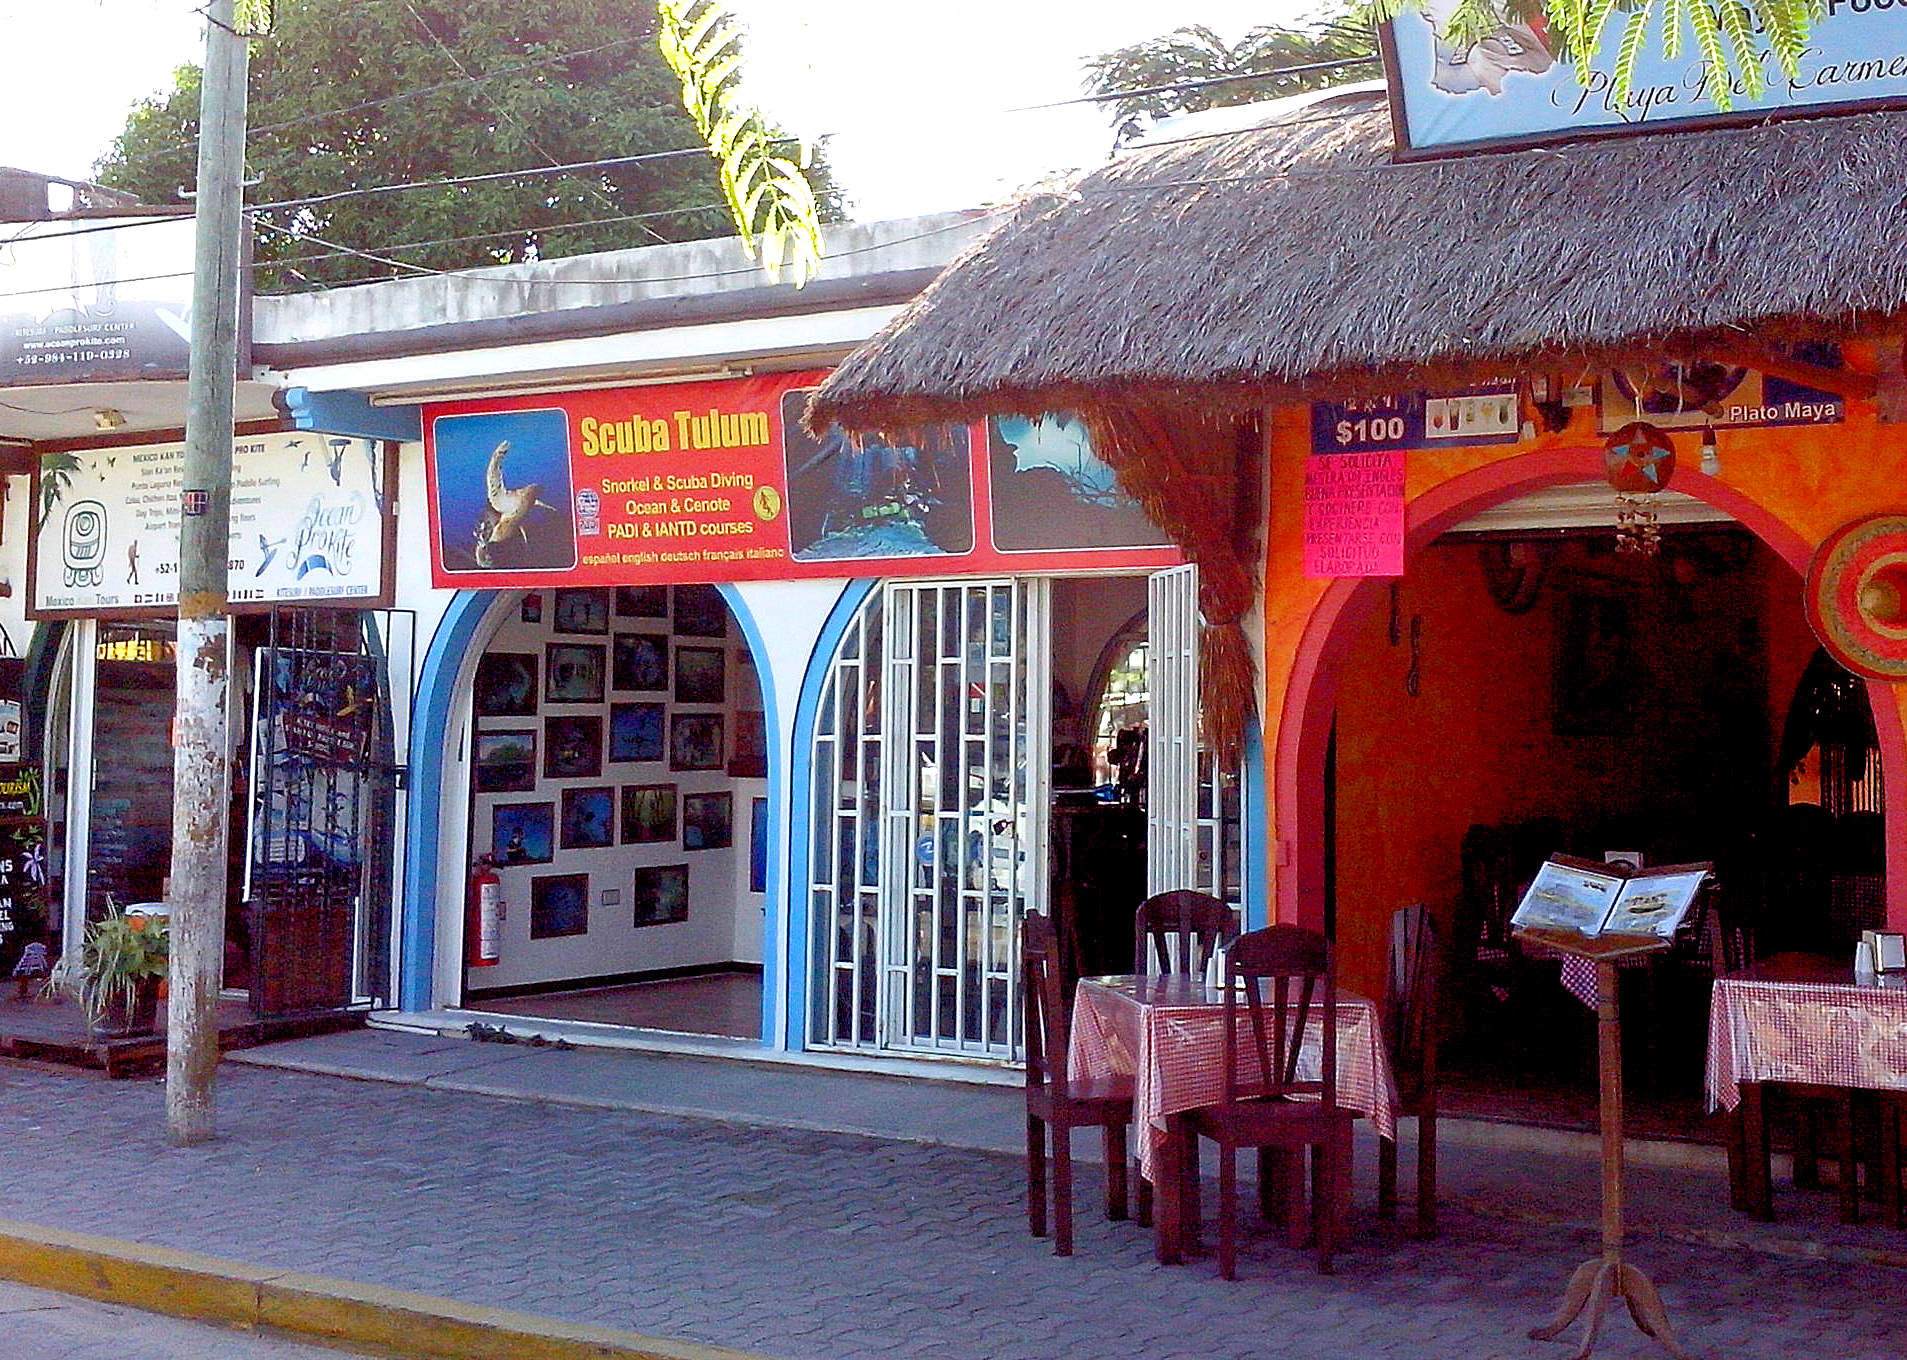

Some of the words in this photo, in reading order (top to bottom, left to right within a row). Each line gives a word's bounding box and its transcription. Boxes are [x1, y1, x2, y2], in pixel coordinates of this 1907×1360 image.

[1551, 70, 1680, 123] Plya
[1767, 48, 1907, 99] Carme
[1730, 405, 1778, 421] Plato
[1784, 400, 1836, 421] Maya
[581, 414, 670, 456] Scuba
[674, 409, 770, 450] Tulum
[1335, 417, 1404, 445] $100
[1340, 453, 1392, 469] SOLICITA
[602, 477, 650, 494] Snorkel
[653, 476, 663, 491] &
[666, 474, 708, 491] Scuba
[711, 472, 753, 490] Diving
[626, 500, 666, 515] Ocean
[670, 498, 681, 513] &
[683, 497, 731, 513] Cenote
[608, 522, 638, 539] PADI
[642, 522, 652, 537] &
[656, 520, 697, 537] IANTD
[700, 521, 753, 536] courses
[622, 551, 658, 565] english
[660, 550, 700, 563] deutsch
[46, 596, 74, 607] Mexico
[96, 593, 119, 605] Tours
